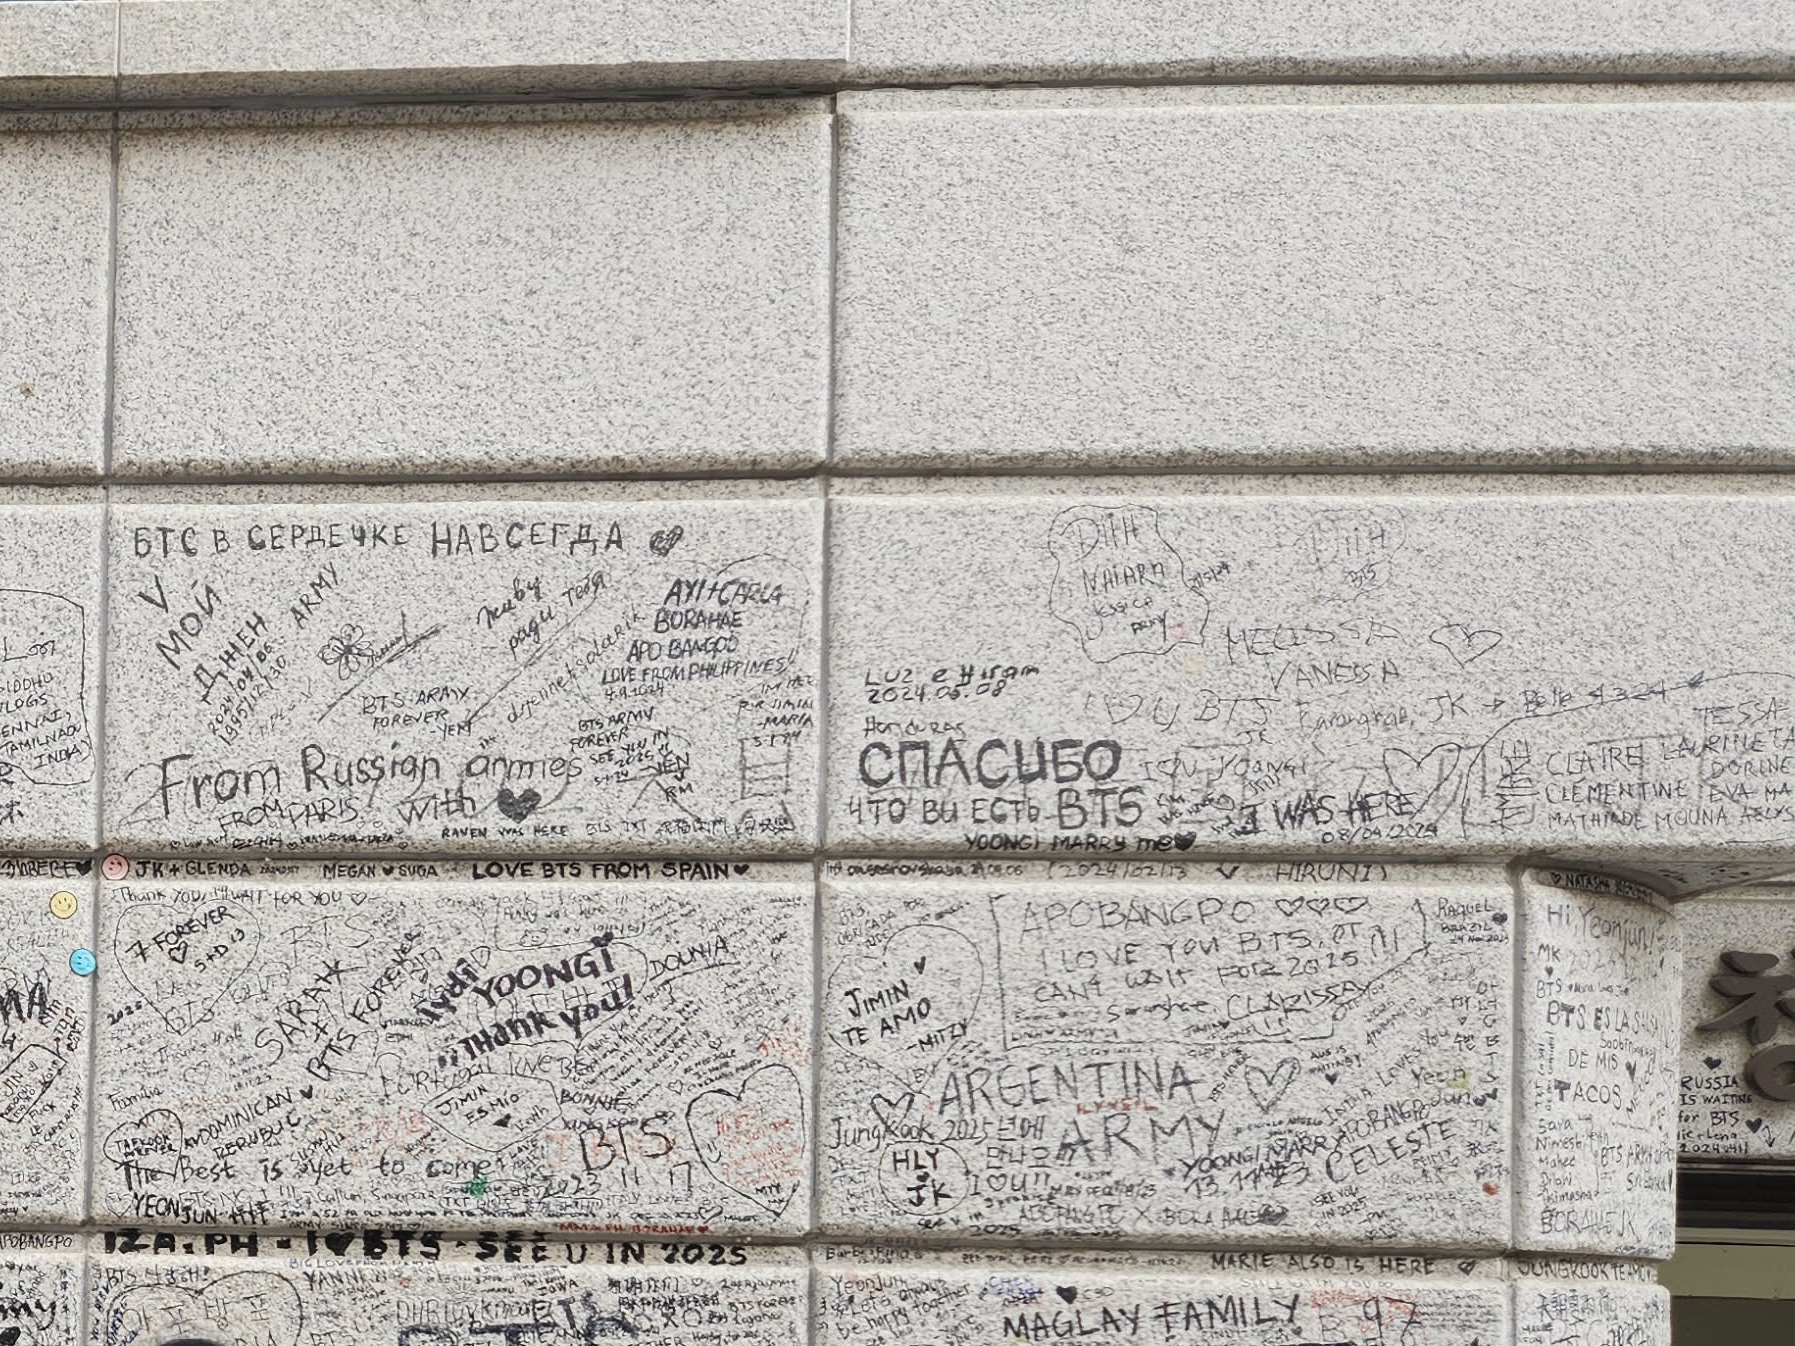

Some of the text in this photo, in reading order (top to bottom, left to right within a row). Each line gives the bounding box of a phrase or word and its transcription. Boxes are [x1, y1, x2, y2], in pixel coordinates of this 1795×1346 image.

[135, 521, 623, 559] БТС В СЕРДЕЧКЕ НАВСЕГДА
[290, 562, 339, 630] ARMY
[156, 584, 223, 670] МОЙ
[655, 609, 742, 633] BORAHAE
[1546, 744, 1645, 779] CLAIRE
[157, 744, 442, 820] From Russian
[397, 792, 478, 827] with
[850, 786, 1146, 830] ЧТО ЕСТЬ BTS
[1654, 807, 1728, 827] MOUNA
[134, 859, 252, 879] JK GLENDA
[322, 862, 440, 880] MEGAN SUGA
[470, 860, 729, 881] LOVE BTS FROM SPAIN
[1436, 897, 1495, 919] RAQUEL
[151, 903, 236, 953] FOREVER
[470, 944, 616, 1004] YOONGI
[843, 976, 911, 1021] JIMIN
[434, 1083, 490, 1117] JIMIN
[937, 1058, 1203, 1118] ARGENTINA
[1553, 1077, 1623, 1107] TACOS
[1680, 1075, 1739, 1092] RUSSIA
[1709, 1109, 1741, 1127] BTS
[1055, 1108, 1225, 1168] ARMY
[1324, 1115, 1456, 1183] CELESTE
[176, 1156, 237, 1184] Best
[306, 1153, 357, 1184] yet
[376, 1149, 406, 1178] to
[363, 1230, 441, 1258] BTS
[475, 1230, 551, 1260] SEE
[564, 1242, 590, 1263] U
[605, 1242, 647, 1265] IN
[661, 1243, 748, 1266] 2025
[1211, 1252, 1437, 1275] MARIE ALSO HERE
[1517, 1257, 1609, 1280] JUNGKOOK
[1001, 1292, 1304, 1343] MAGLAY FAMILY
